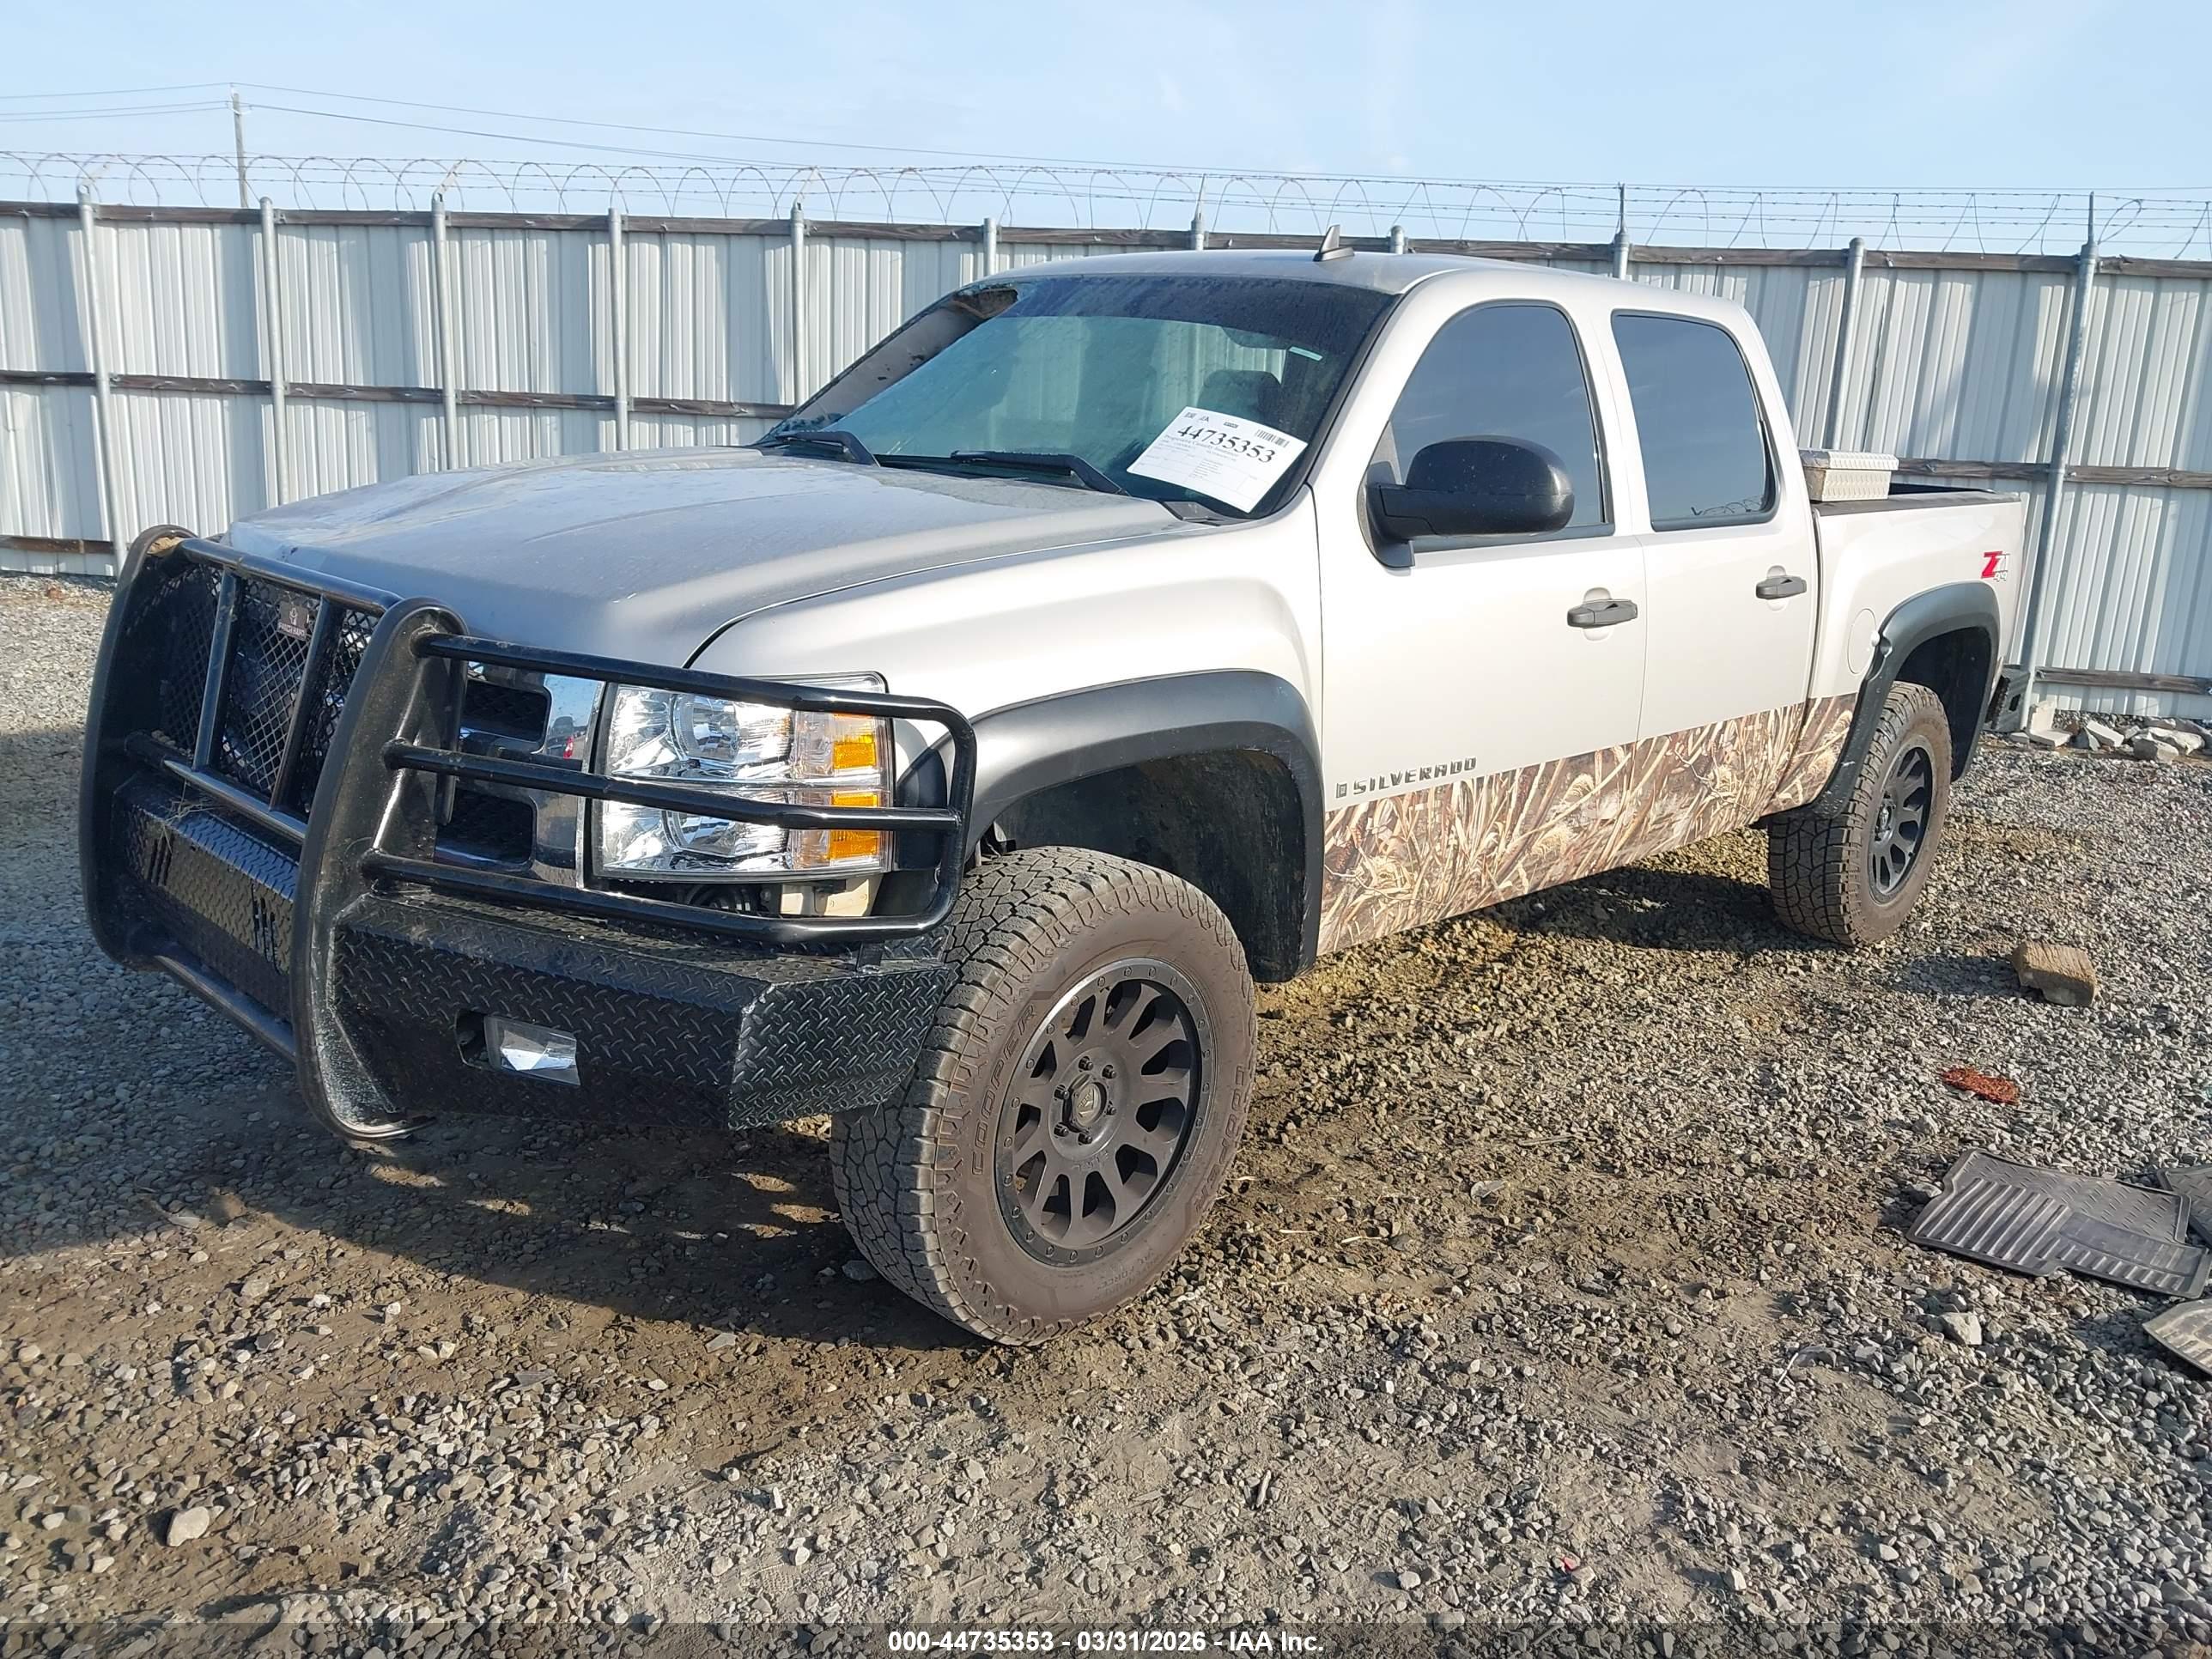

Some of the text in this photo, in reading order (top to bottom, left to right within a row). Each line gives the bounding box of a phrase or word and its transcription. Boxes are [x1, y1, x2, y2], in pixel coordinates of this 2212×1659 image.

[1177, 425, 1276, 464] 44735353
[1353, 757, 1476, 795] SILVERADO
[972, 1004, 1035, 1176] COOPER
